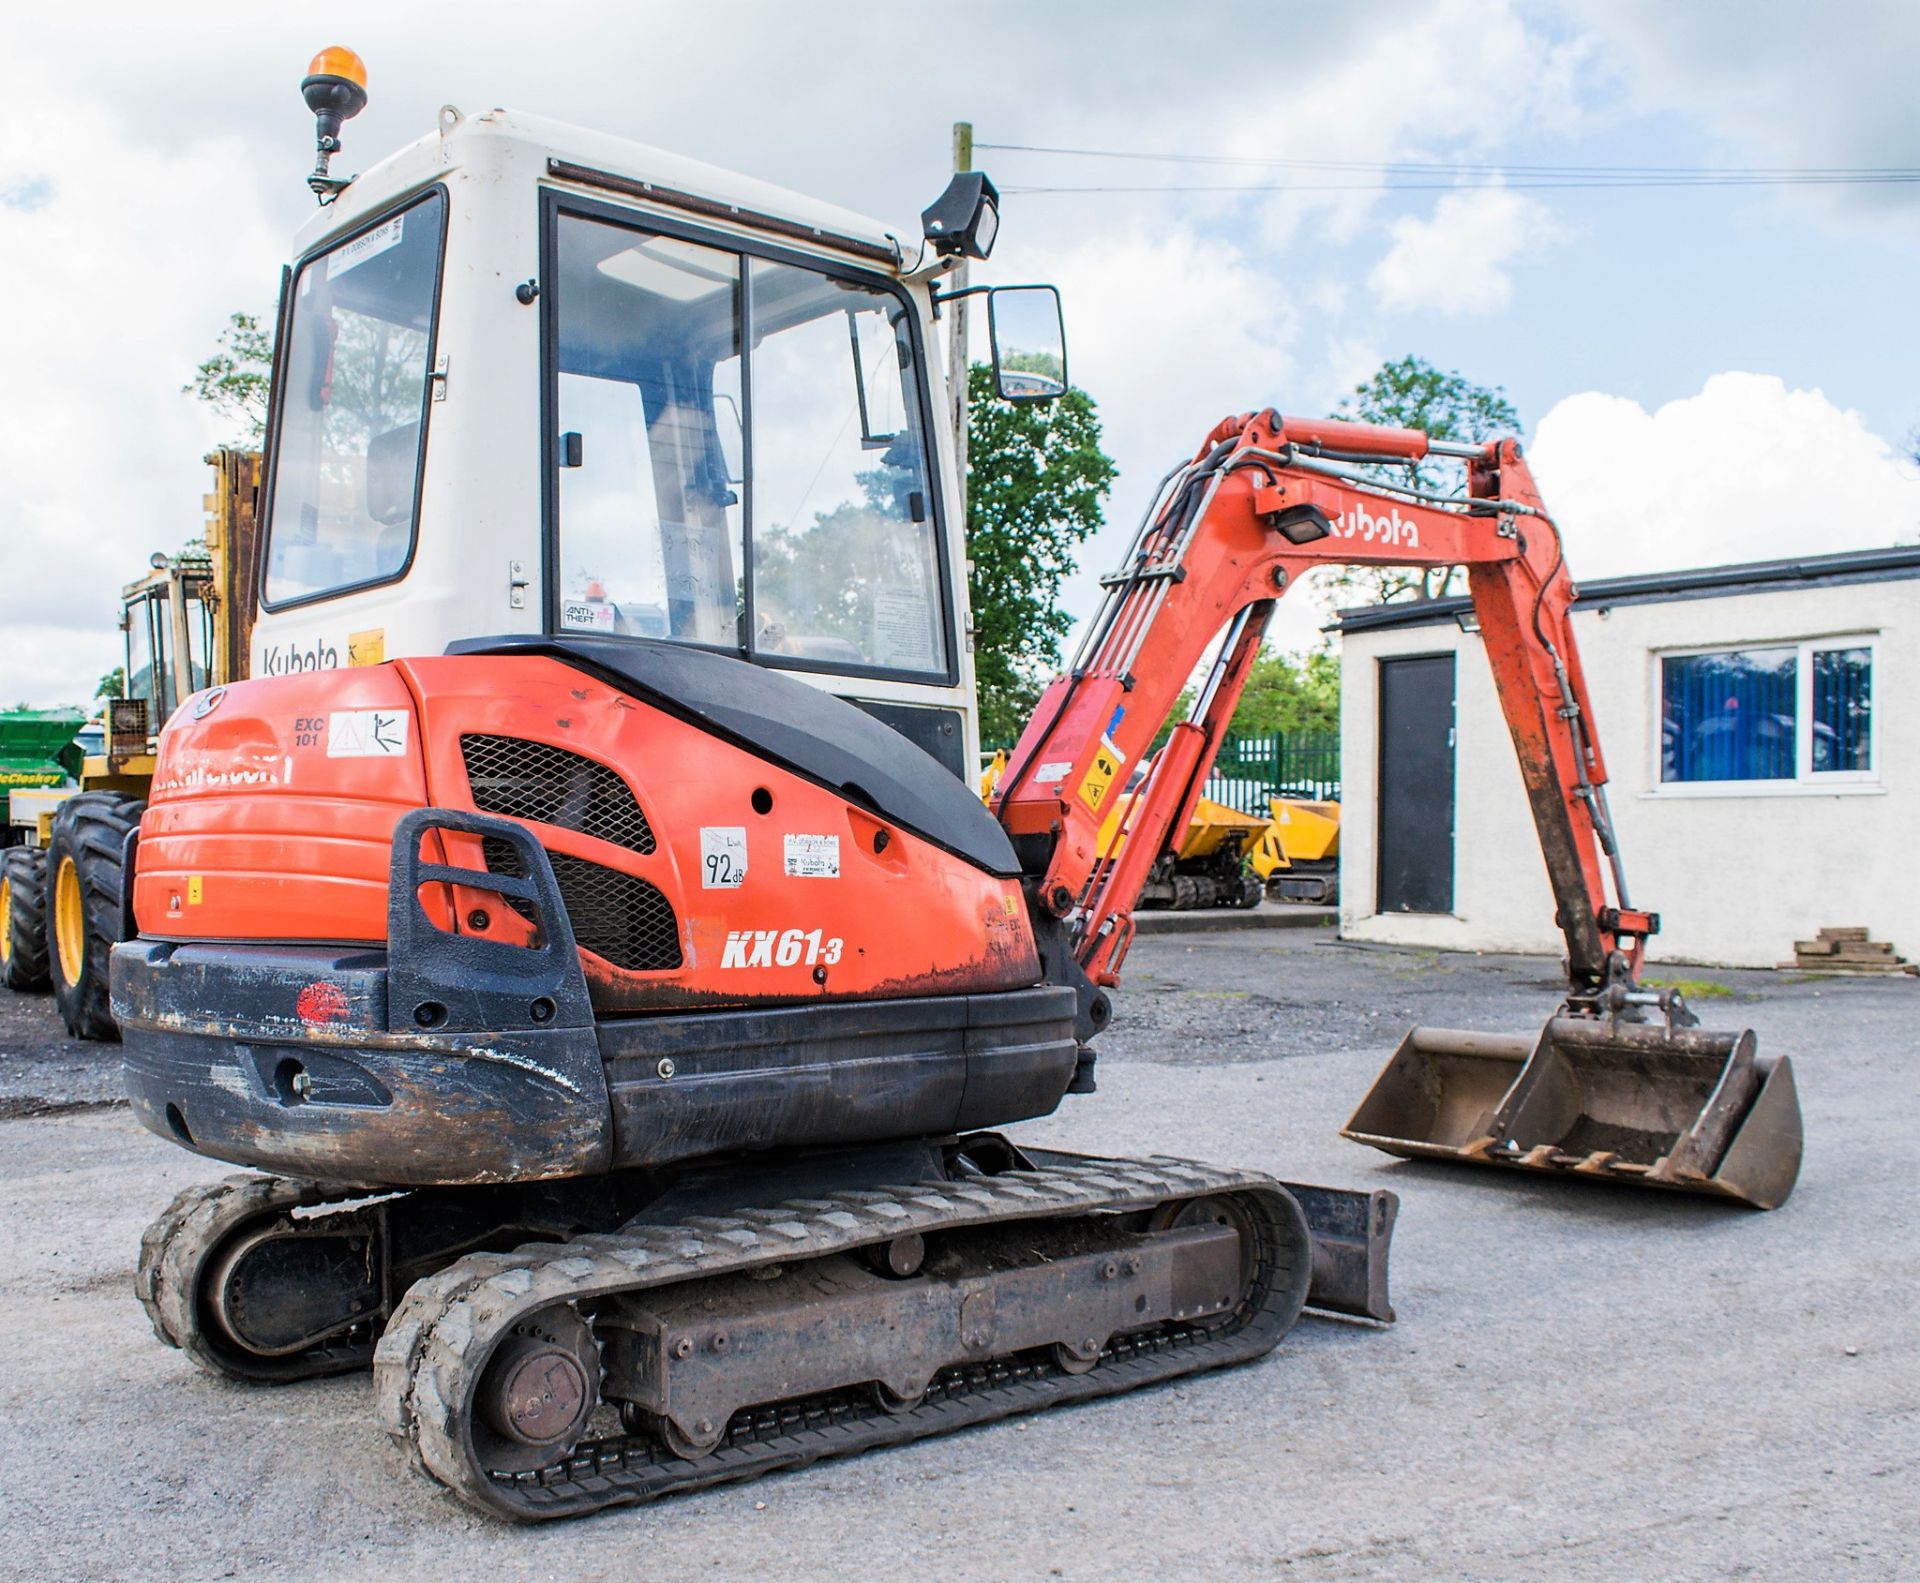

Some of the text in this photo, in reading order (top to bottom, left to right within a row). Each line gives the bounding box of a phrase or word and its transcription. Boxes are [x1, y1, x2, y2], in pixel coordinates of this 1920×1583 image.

[565, 606, 589, 615] ANTI
[565, 614, 595, 624] THEFT
[263, 638, 338, 677] Kubota
[294, 718, 325, 732] EXC
[295, 734, 319, 747] 101
[0, 772, 61, 785] cCloskey
[720, 928, 844, 969] KX61-3
